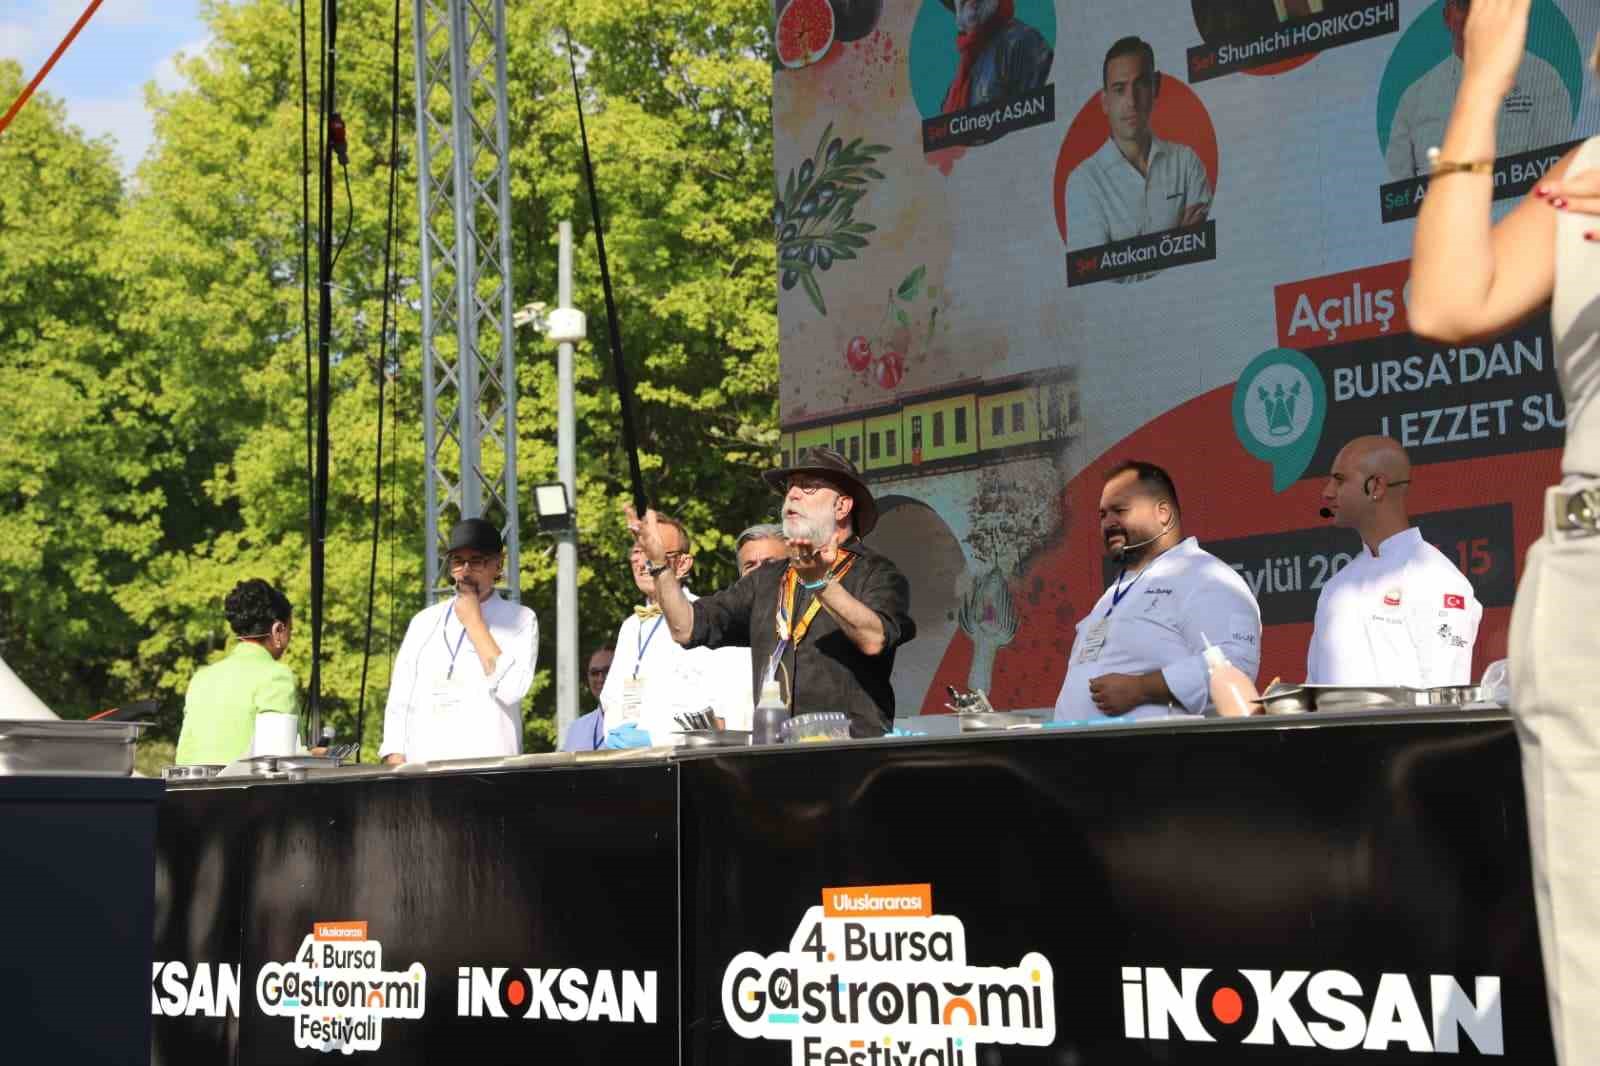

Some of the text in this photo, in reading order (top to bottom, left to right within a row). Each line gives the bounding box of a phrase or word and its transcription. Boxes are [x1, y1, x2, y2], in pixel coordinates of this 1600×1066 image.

[1218, 29, 1290, 64] Shunichi
[1293, 2, 1394, 45] HORIKOSHI
[950, 109, 1001, 134] Cüneyt
[1002, 95, 1045, 121] ASAN
[1100, 245, 1157, 269] Atakan
[1159, 231, 1206, 256] ÖZEN
[1288, 283, 1395, 341] Açılış
[1334, 337, 1542, 402] BURSA'DAN
[1232, 555, 1302, 598] ylül
[833, 893, 922, 912] Uluslararası
[302, 944, 376, 969] 4. Bursa
[801, 922, 953, 962] 4. Bursa
[300, 1014, 376, 1044] Festivali
